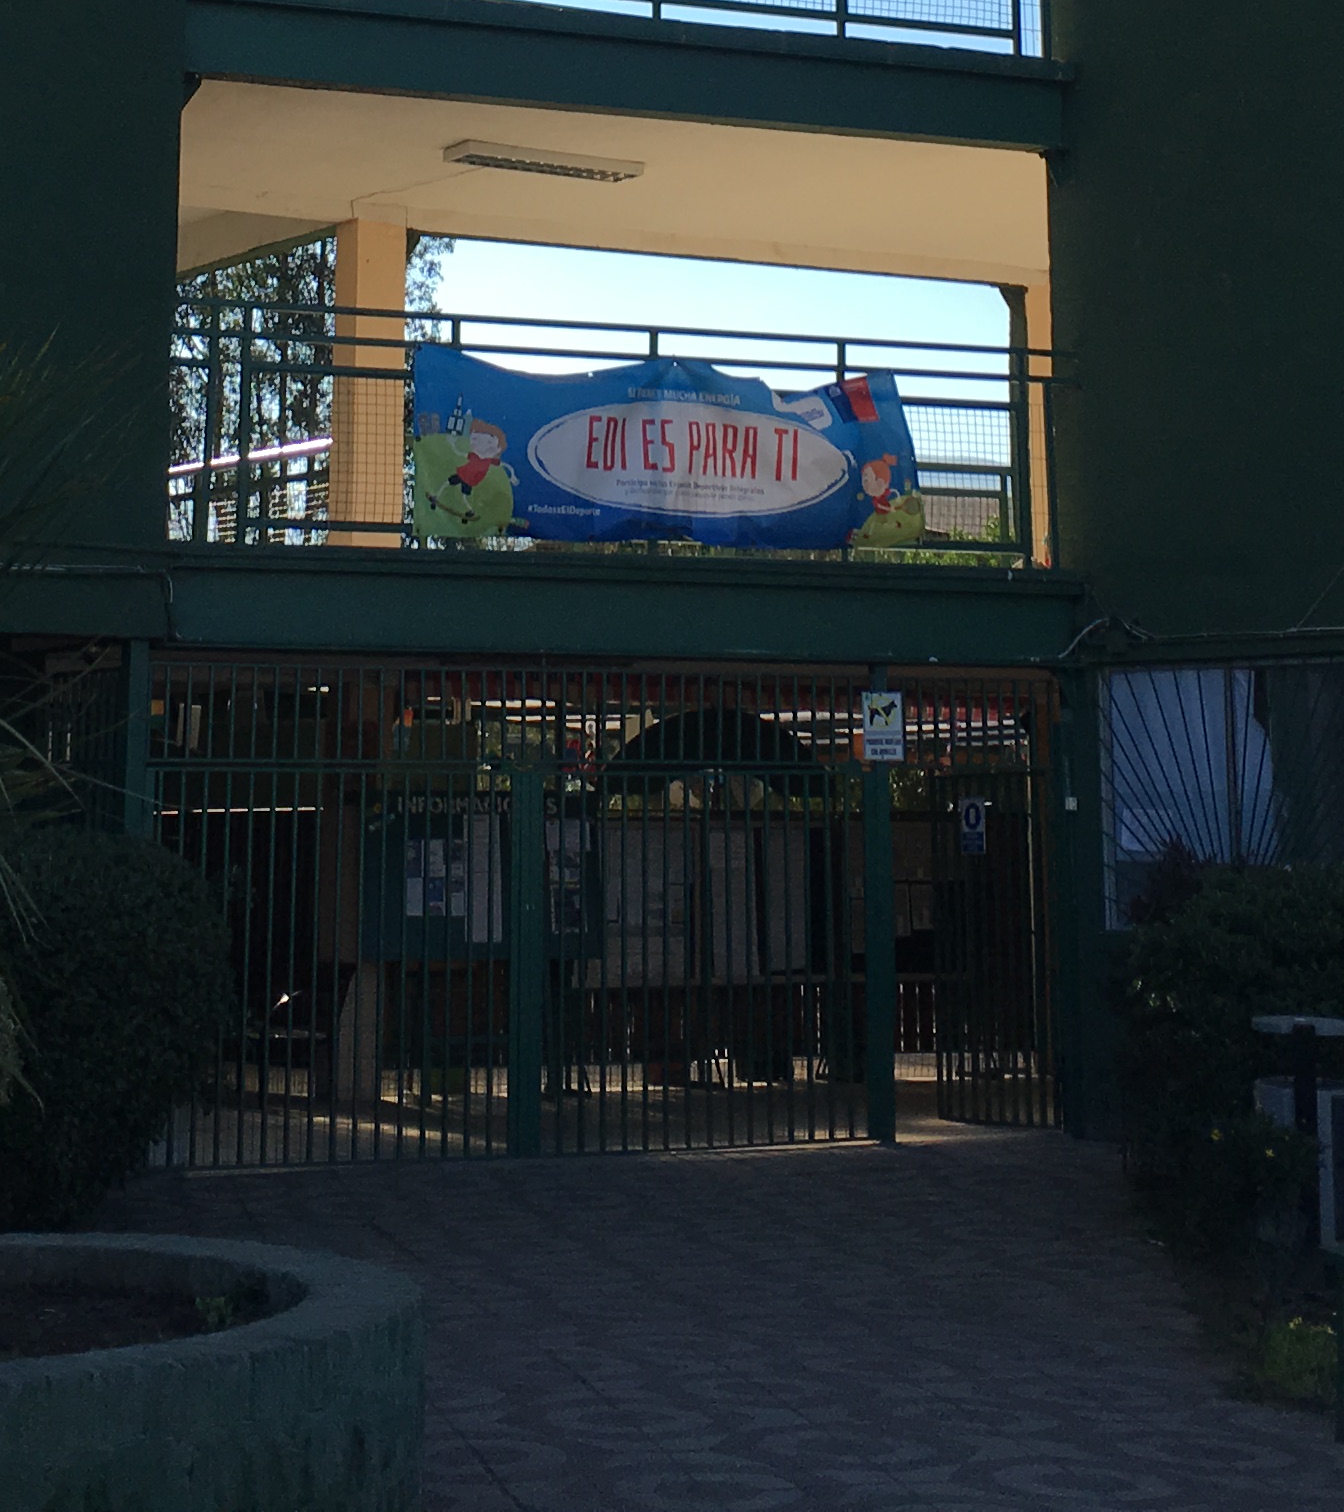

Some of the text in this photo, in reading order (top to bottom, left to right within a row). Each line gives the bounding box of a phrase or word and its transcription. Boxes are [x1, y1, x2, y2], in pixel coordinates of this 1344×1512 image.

[663, 389, 697, 401] MUCHA
[586, 415, 799, 482] EDI ES PARA TI
